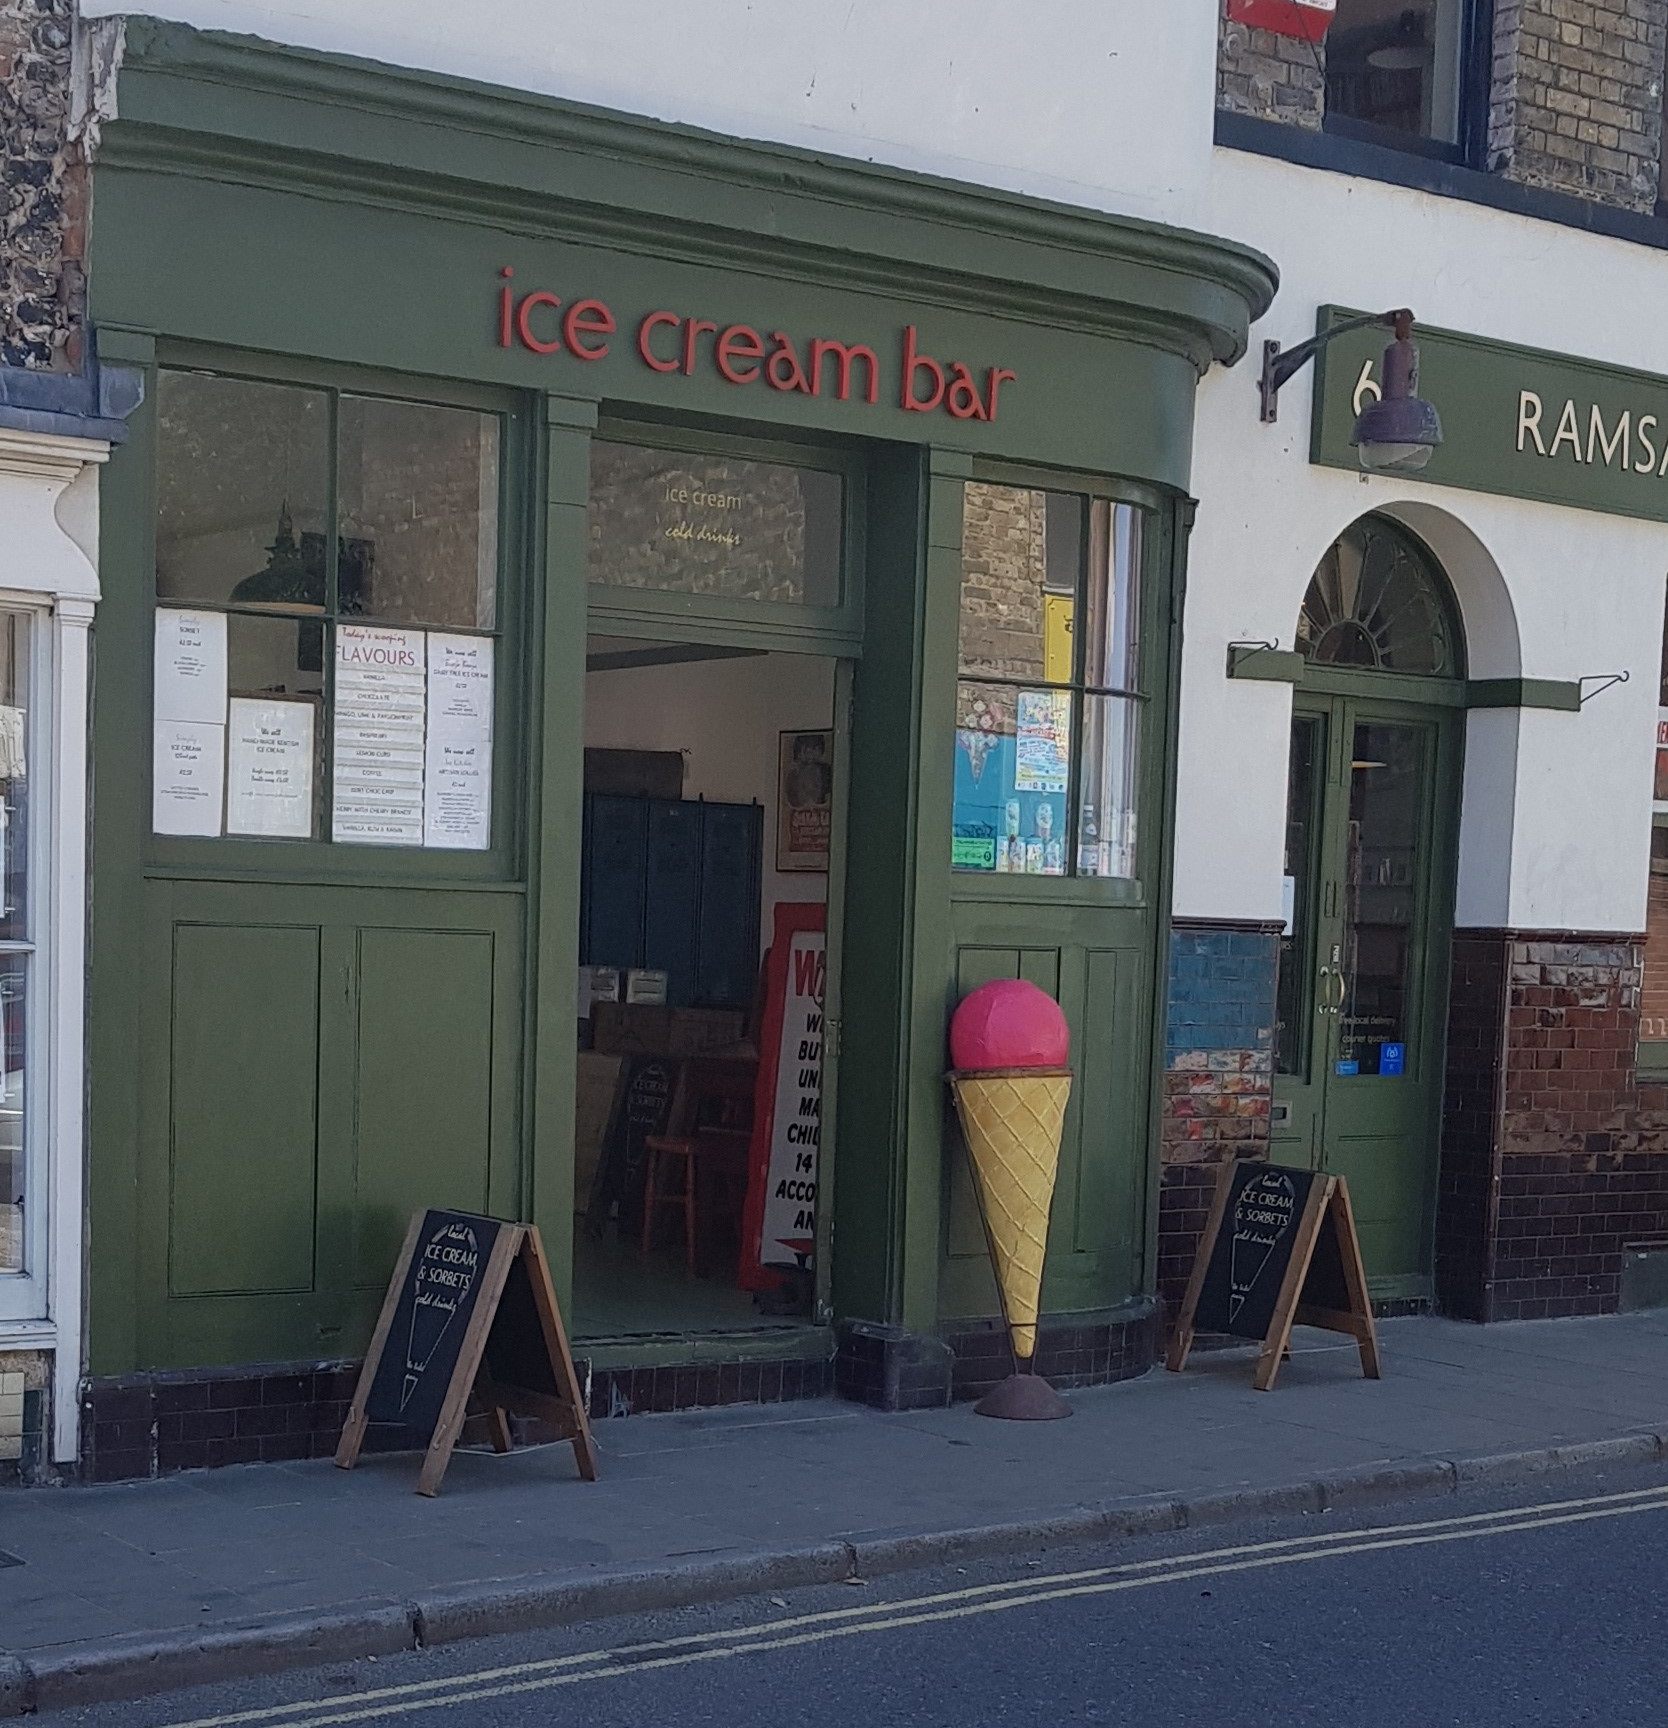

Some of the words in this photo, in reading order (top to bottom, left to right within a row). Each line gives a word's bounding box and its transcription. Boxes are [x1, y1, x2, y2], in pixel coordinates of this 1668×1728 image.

[498, 266, 617, 361] ice
[638, 311, 880, 405] cream
[900, 325, 1017, 422] bar
[665, 483, 688, 504] ice
[693, 491, 742, 510] cream
[665, 520, 694, 540] cold
[697, 525, 740, 545] drinks
[806, 1013, 823, 1034] W
[798, 1040, 819, 1061] BU
[799, 1068, 820, 1089] UN
[799, 1097, 819, 1117] MA
[787, 1123, 819, 1146] CHIL
[795, 1153, 813, 1174] 14
[775, 1179, 816, 1202] ACCO
[1240, 1189, 1258, 1204] ICE
[1258, 1192, 1294, 1209] CREAM
[1235, 1207, 1244, 1220] &
[1246, 1208, 1289, 1227] SORBETS
[424, 1244, 442, 1260] ICE
[442, 1246, 478, 1267] CREAM
[417, 1265, 427, 1280] &
[427, 1267, 472, 1291] SORBETS
